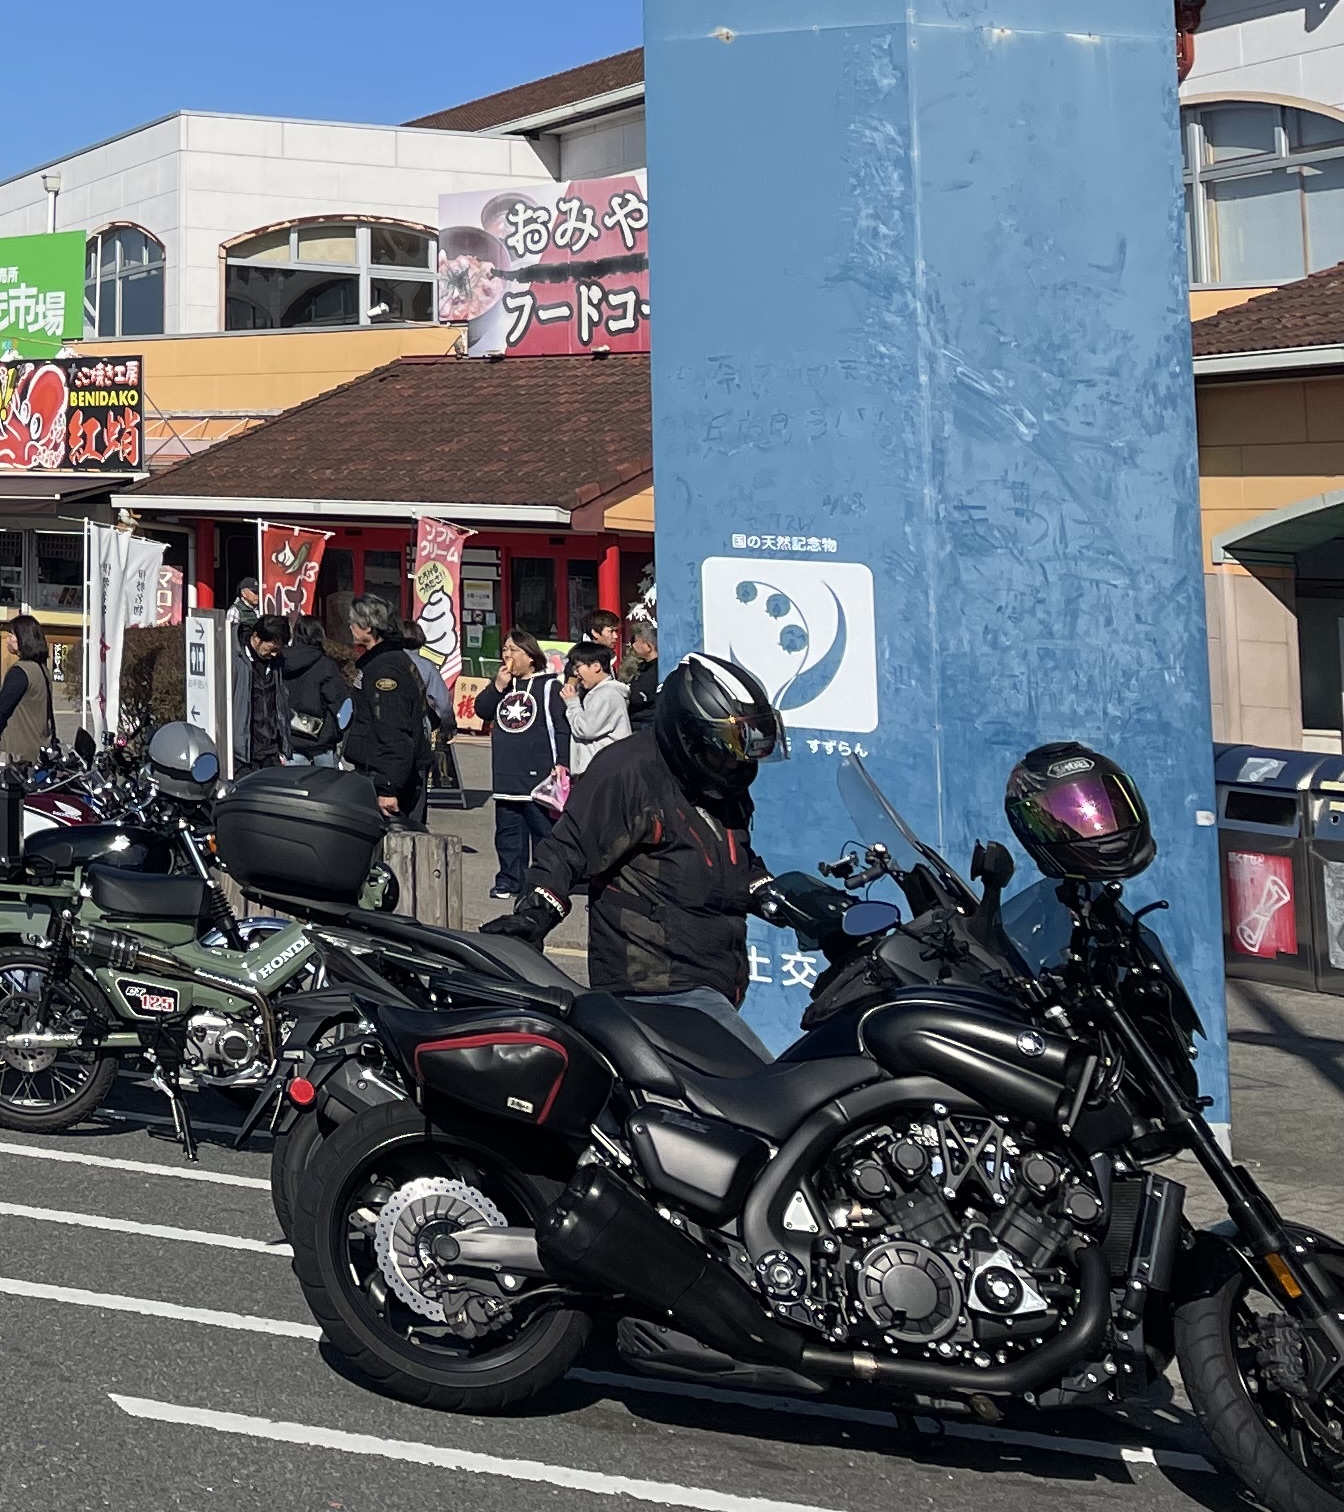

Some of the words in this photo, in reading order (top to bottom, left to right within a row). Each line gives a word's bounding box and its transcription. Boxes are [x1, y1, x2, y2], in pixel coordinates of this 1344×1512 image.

[506, 193, 649, 256] おみや
[505, 284, 650, 343] フードコ
[69, 390, 139, 408] BENIDAKO
[68, 407, 140, 467] 紅蛸
[425, 524, 456, 545] ソフト
[731, 533, 838, 553] 国の天然記念物
[419, 539, 460, 563] クリーム
[806, 738, 869, 758] すずらん
[141, 994, 175, 1013] 125
